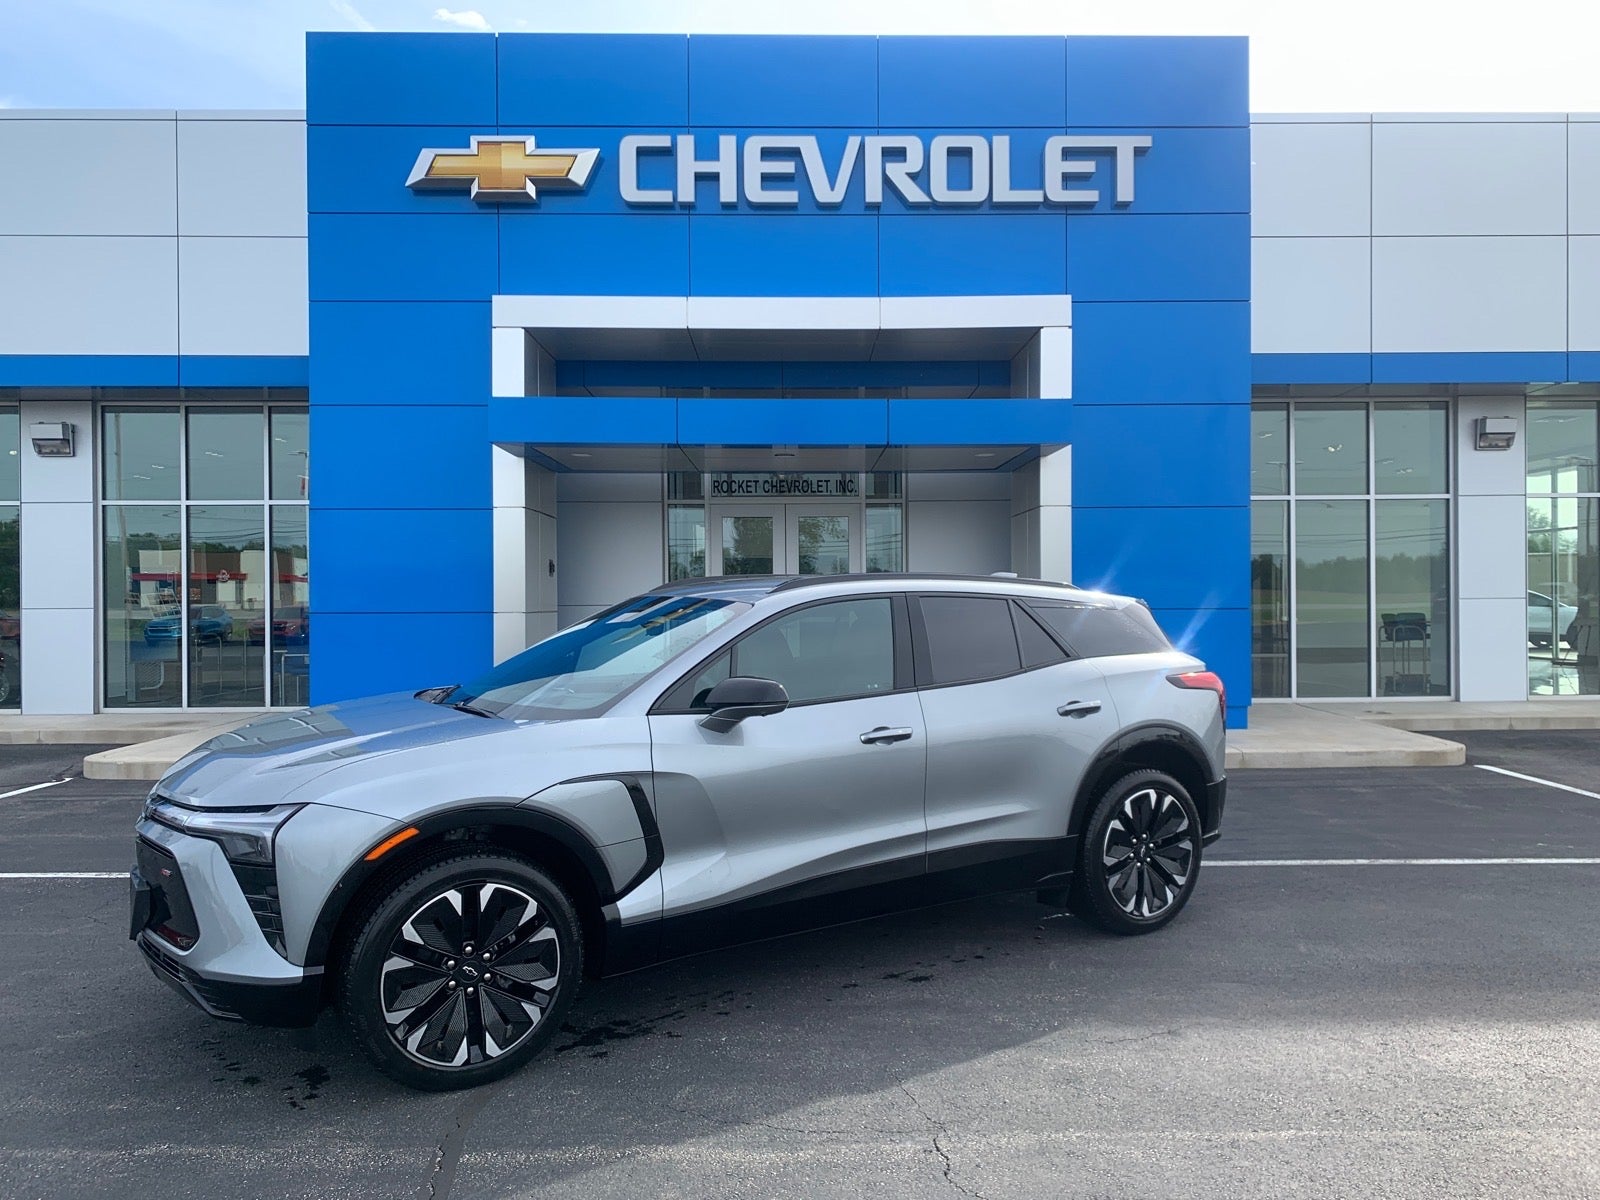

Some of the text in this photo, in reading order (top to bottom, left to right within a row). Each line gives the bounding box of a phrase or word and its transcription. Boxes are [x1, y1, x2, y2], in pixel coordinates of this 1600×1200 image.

[618, 134, 1153, 205] CHEVROLET
[712, 479, 858, 494] ROCKET CHEVROLET, INC.
